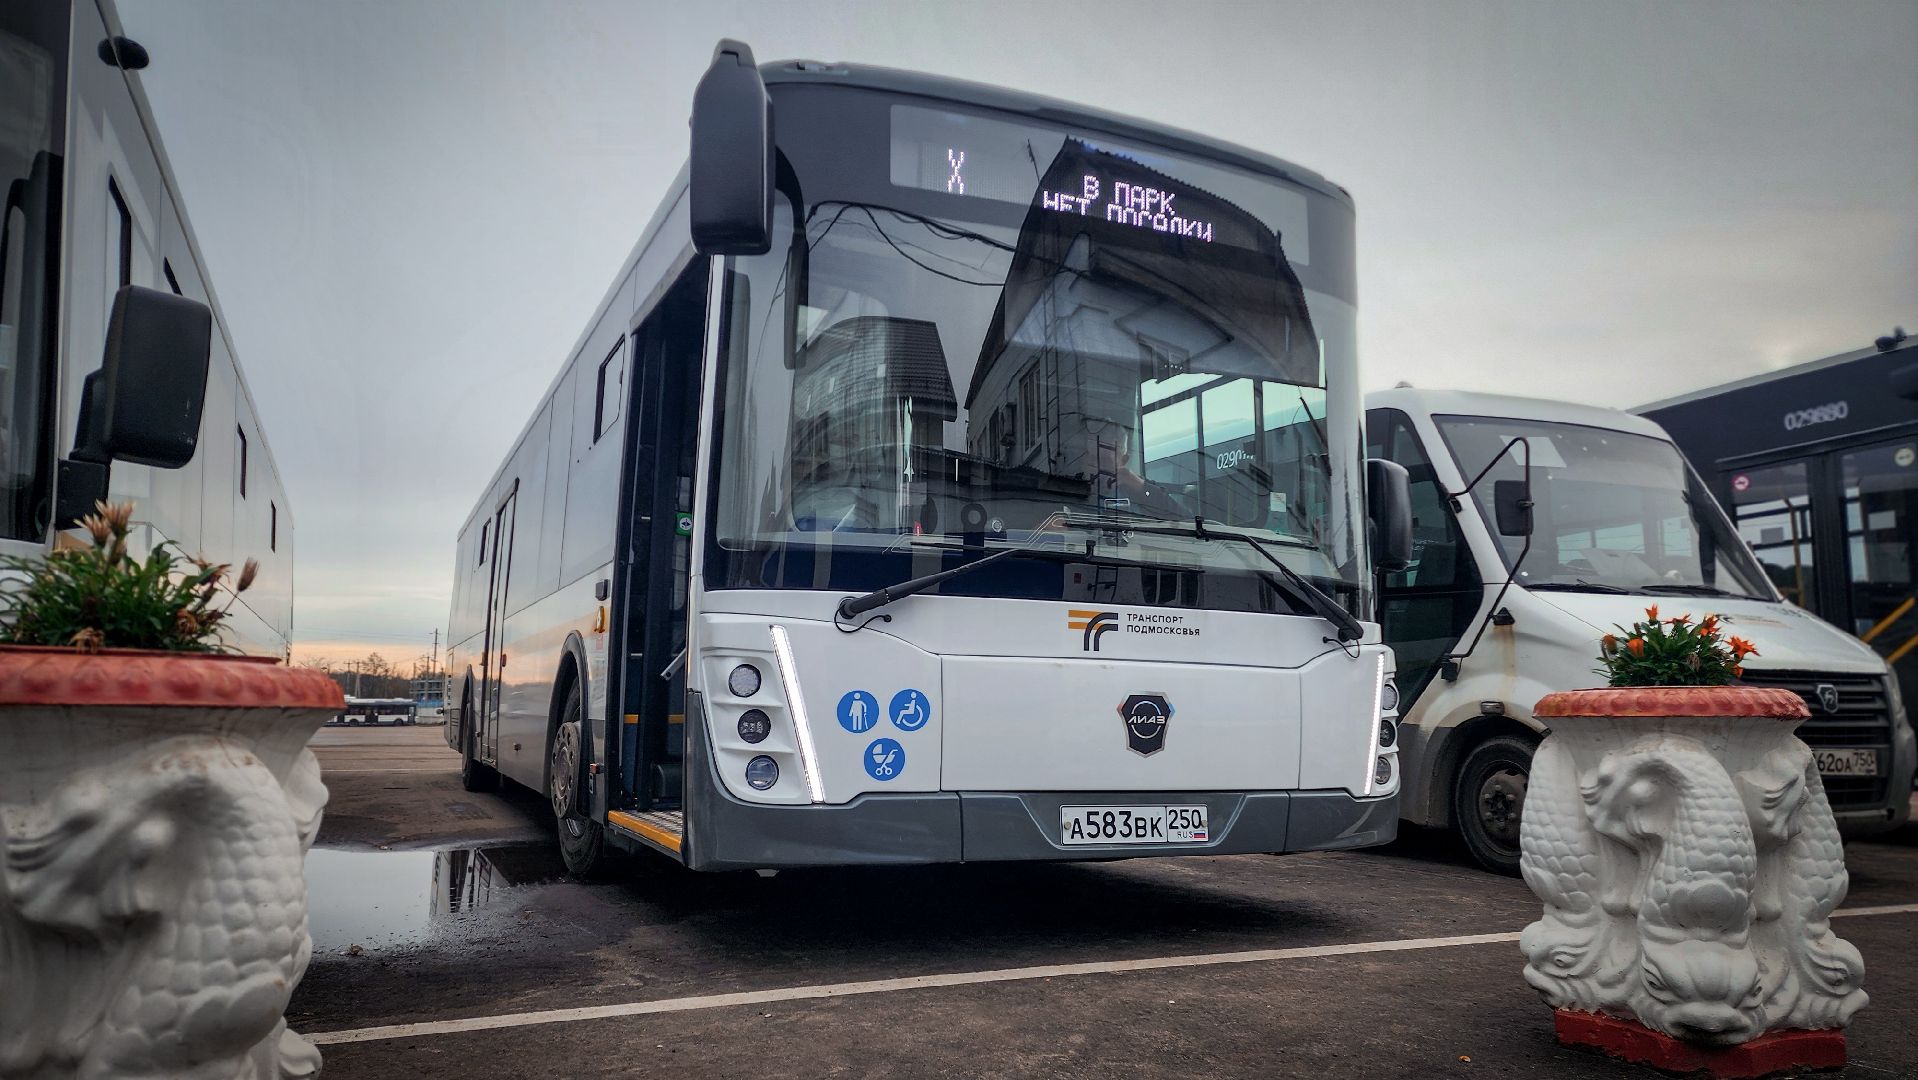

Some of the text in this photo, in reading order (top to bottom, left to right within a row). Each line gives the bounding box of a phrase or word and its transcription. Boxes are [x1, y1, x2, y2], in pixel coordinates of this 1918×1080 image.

[1083, 175, 1176, 216] В ПАРК
[1043, 190, 1091, 216] НЕТ
[1127, 613, 1184, 625] ТРАНСПОРТ
[1126, 625, 1200, 636] ПОДМОСКОВЬЯ
[1128, 715, 1165, 724] ЛИАЗ
[1168, 809, 1202, 830] 250
[1177, 831, 1194, 839] RUS
